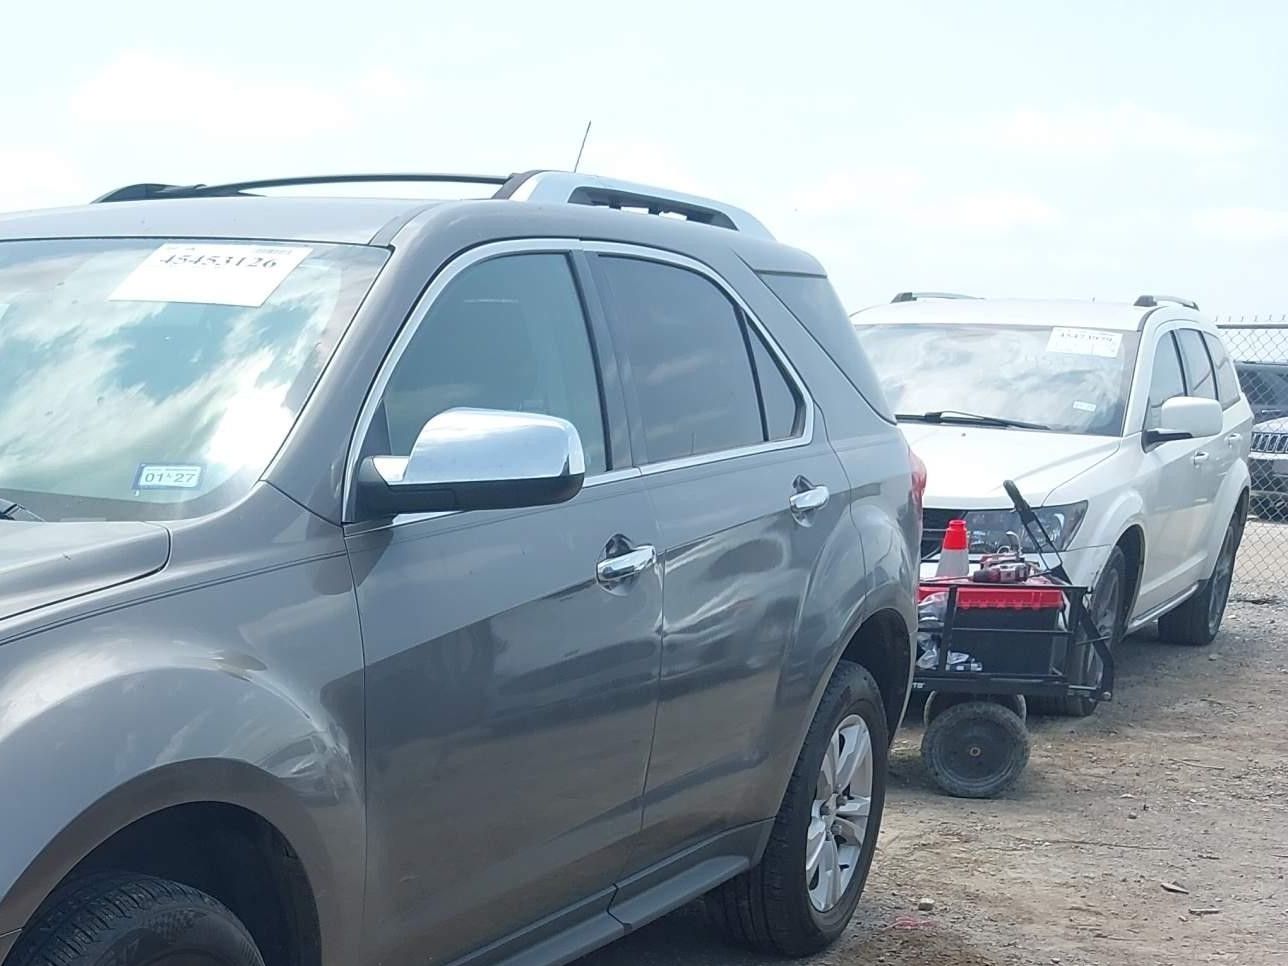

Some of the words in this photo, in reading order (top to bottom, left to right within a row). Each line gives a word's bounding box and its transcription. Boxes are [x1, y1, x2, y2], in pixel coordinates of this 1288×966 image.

[159, 253, 278, 269] 45453126
[144, 472, 164, 483] 01
[174, 472, 197, 483] 27
